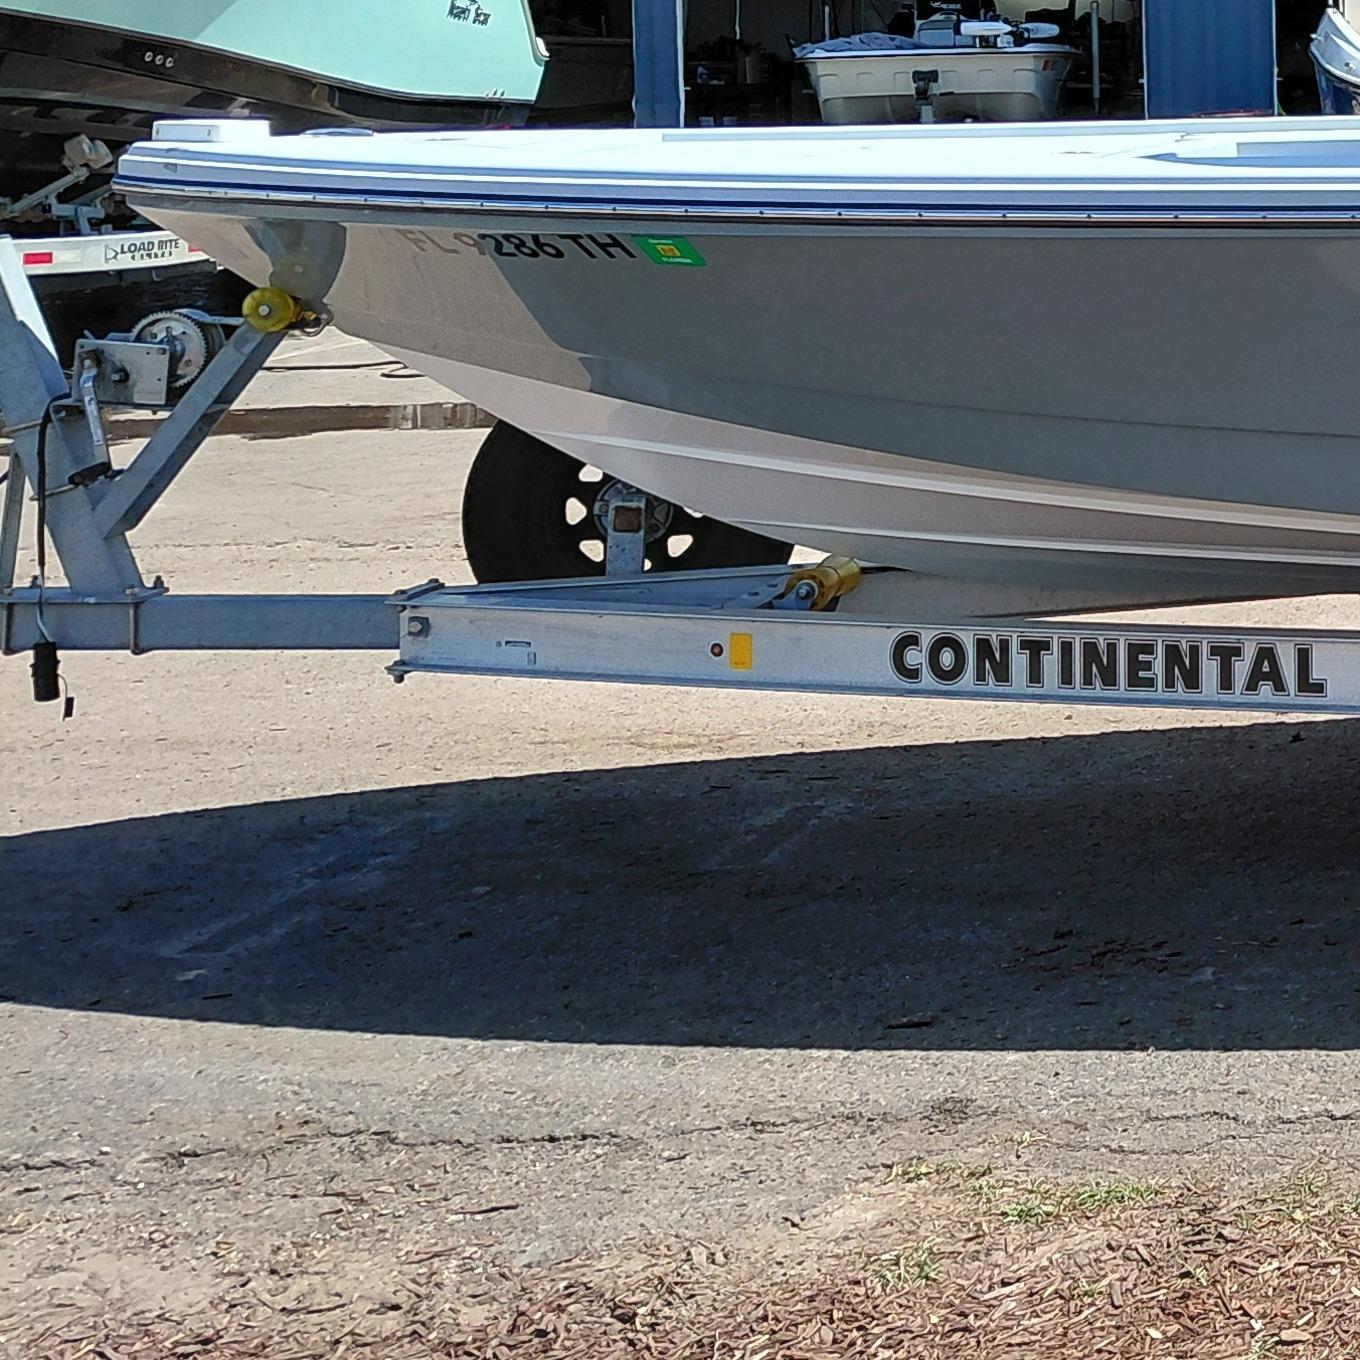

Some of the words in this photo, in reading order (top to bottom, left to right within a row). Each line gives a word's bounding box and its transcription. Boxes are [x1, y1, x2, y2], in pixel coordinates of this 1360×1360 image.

[120, 241, 155, 255] LOAD
[158, 238, 181, 251] RITE
[394, 228, 460, 254] FL
[452, 232, 565, 259] 9286
[558, 233, 638, 259] TH
[890, 631, 1328, 698] CONTINENTAL
